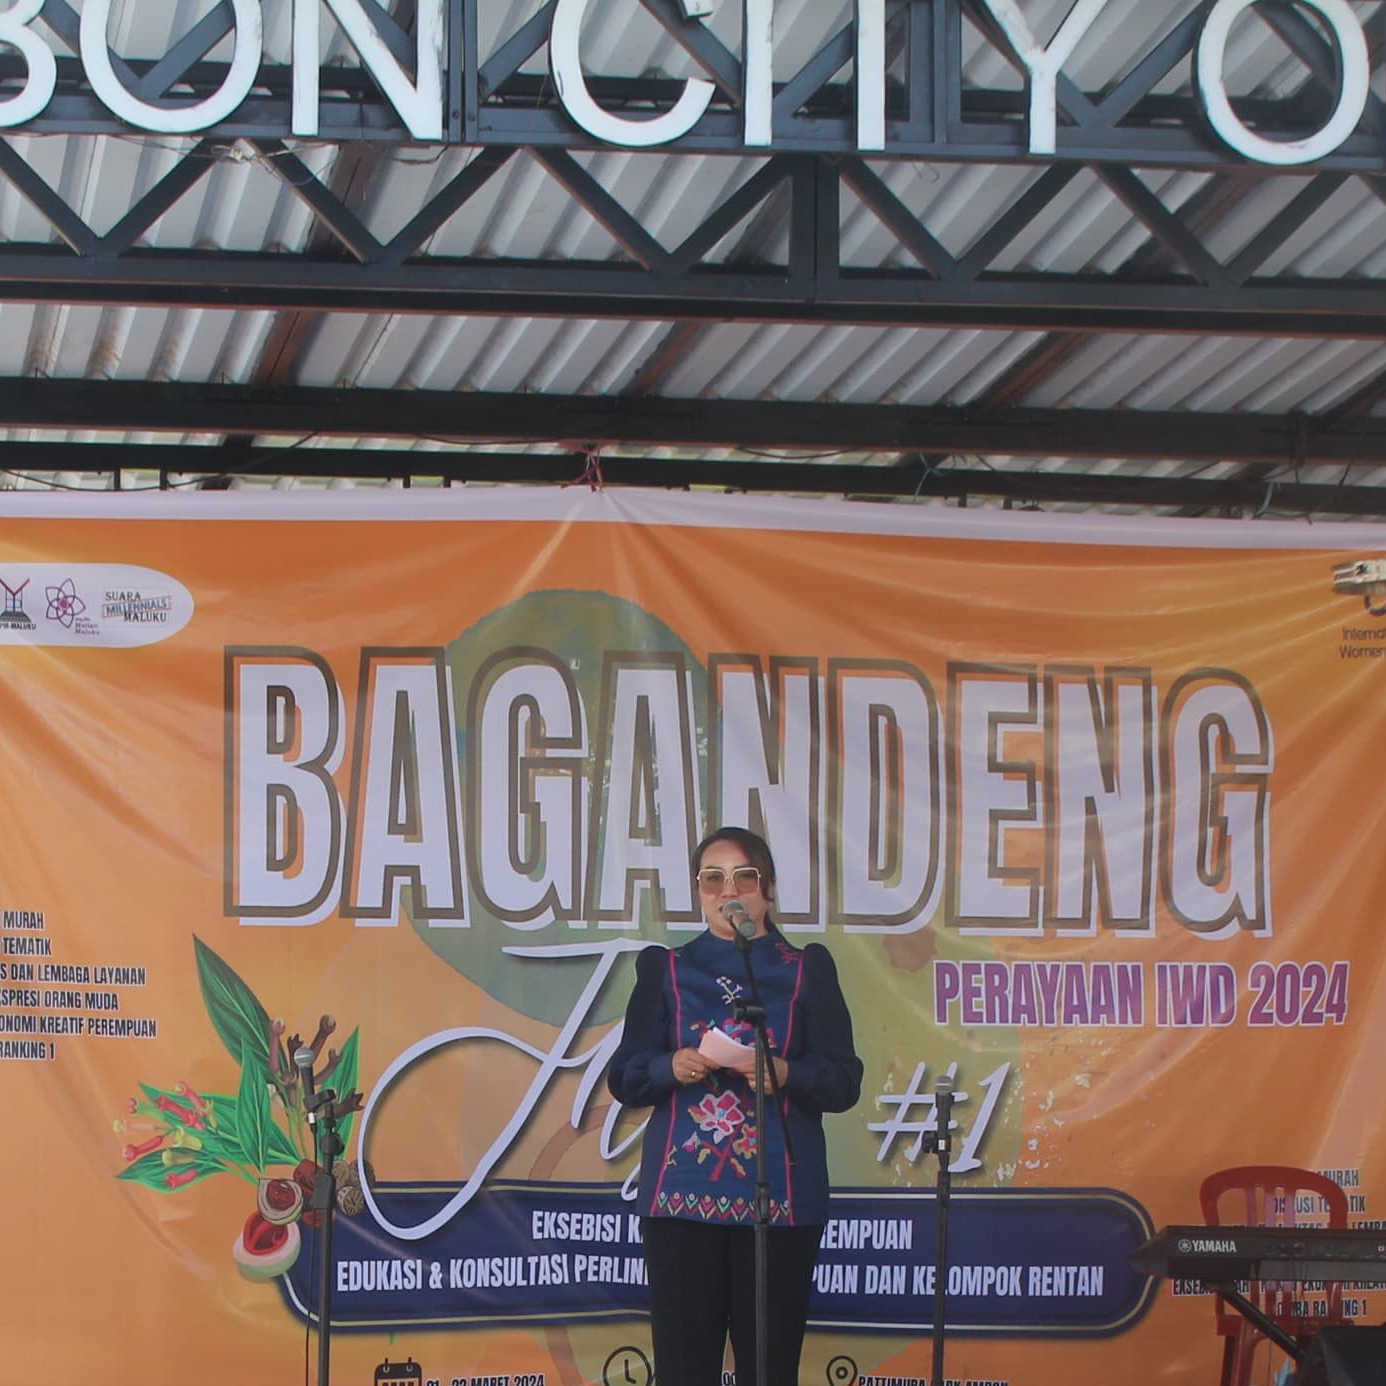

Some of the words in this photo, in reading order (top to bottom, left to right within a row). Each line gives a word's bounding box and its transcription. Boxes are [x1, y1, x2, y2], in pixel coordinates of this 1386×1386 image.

[105, 591, 141, 601] SUARA
[124, 613, 167, 622] MALUKU
[224, 645, 1274, 938] BAGANDENG
[3, 910, 44, 929] MURAH
[3, 937, 52, 956] TEMATIK
[10, 963, 34, 981] DAN
[37, 964, 90, 983] LEMBAGA
[93, 967, 146, 985] LAYANAN
[44, 991, 81, 1009] ORANG
[85, 992, 119, 1011] MUDA
[933, 960, 1144, 1026] PERAYAAN
[1154, 961, 1237, 1027] IWD
[1247, 961, 1350, 1027] 2024
[40, 1016, 84, 1034] KREATIF
[88, 1018, 157, 1037] PEREMPUAN
[49, 1042, 55, 1059] 1
[867, 1061, 1010, 1173] #1
[532, 1210, 620, 1243] EKSEBISI
[1192, 1239, 1237, 1253] YAMAHA
[337, 1259, 422, 1291] EDUKASI
[428, 1261, 443, 1289] &
[449, 1253, 570, 1290] KONSULTASI
[865, 1265, 906, 1295] DAN
[912, 1265, 1023, 1297] KEOMPOK
[1028, 1265, 1104, 1297] RENTAN
